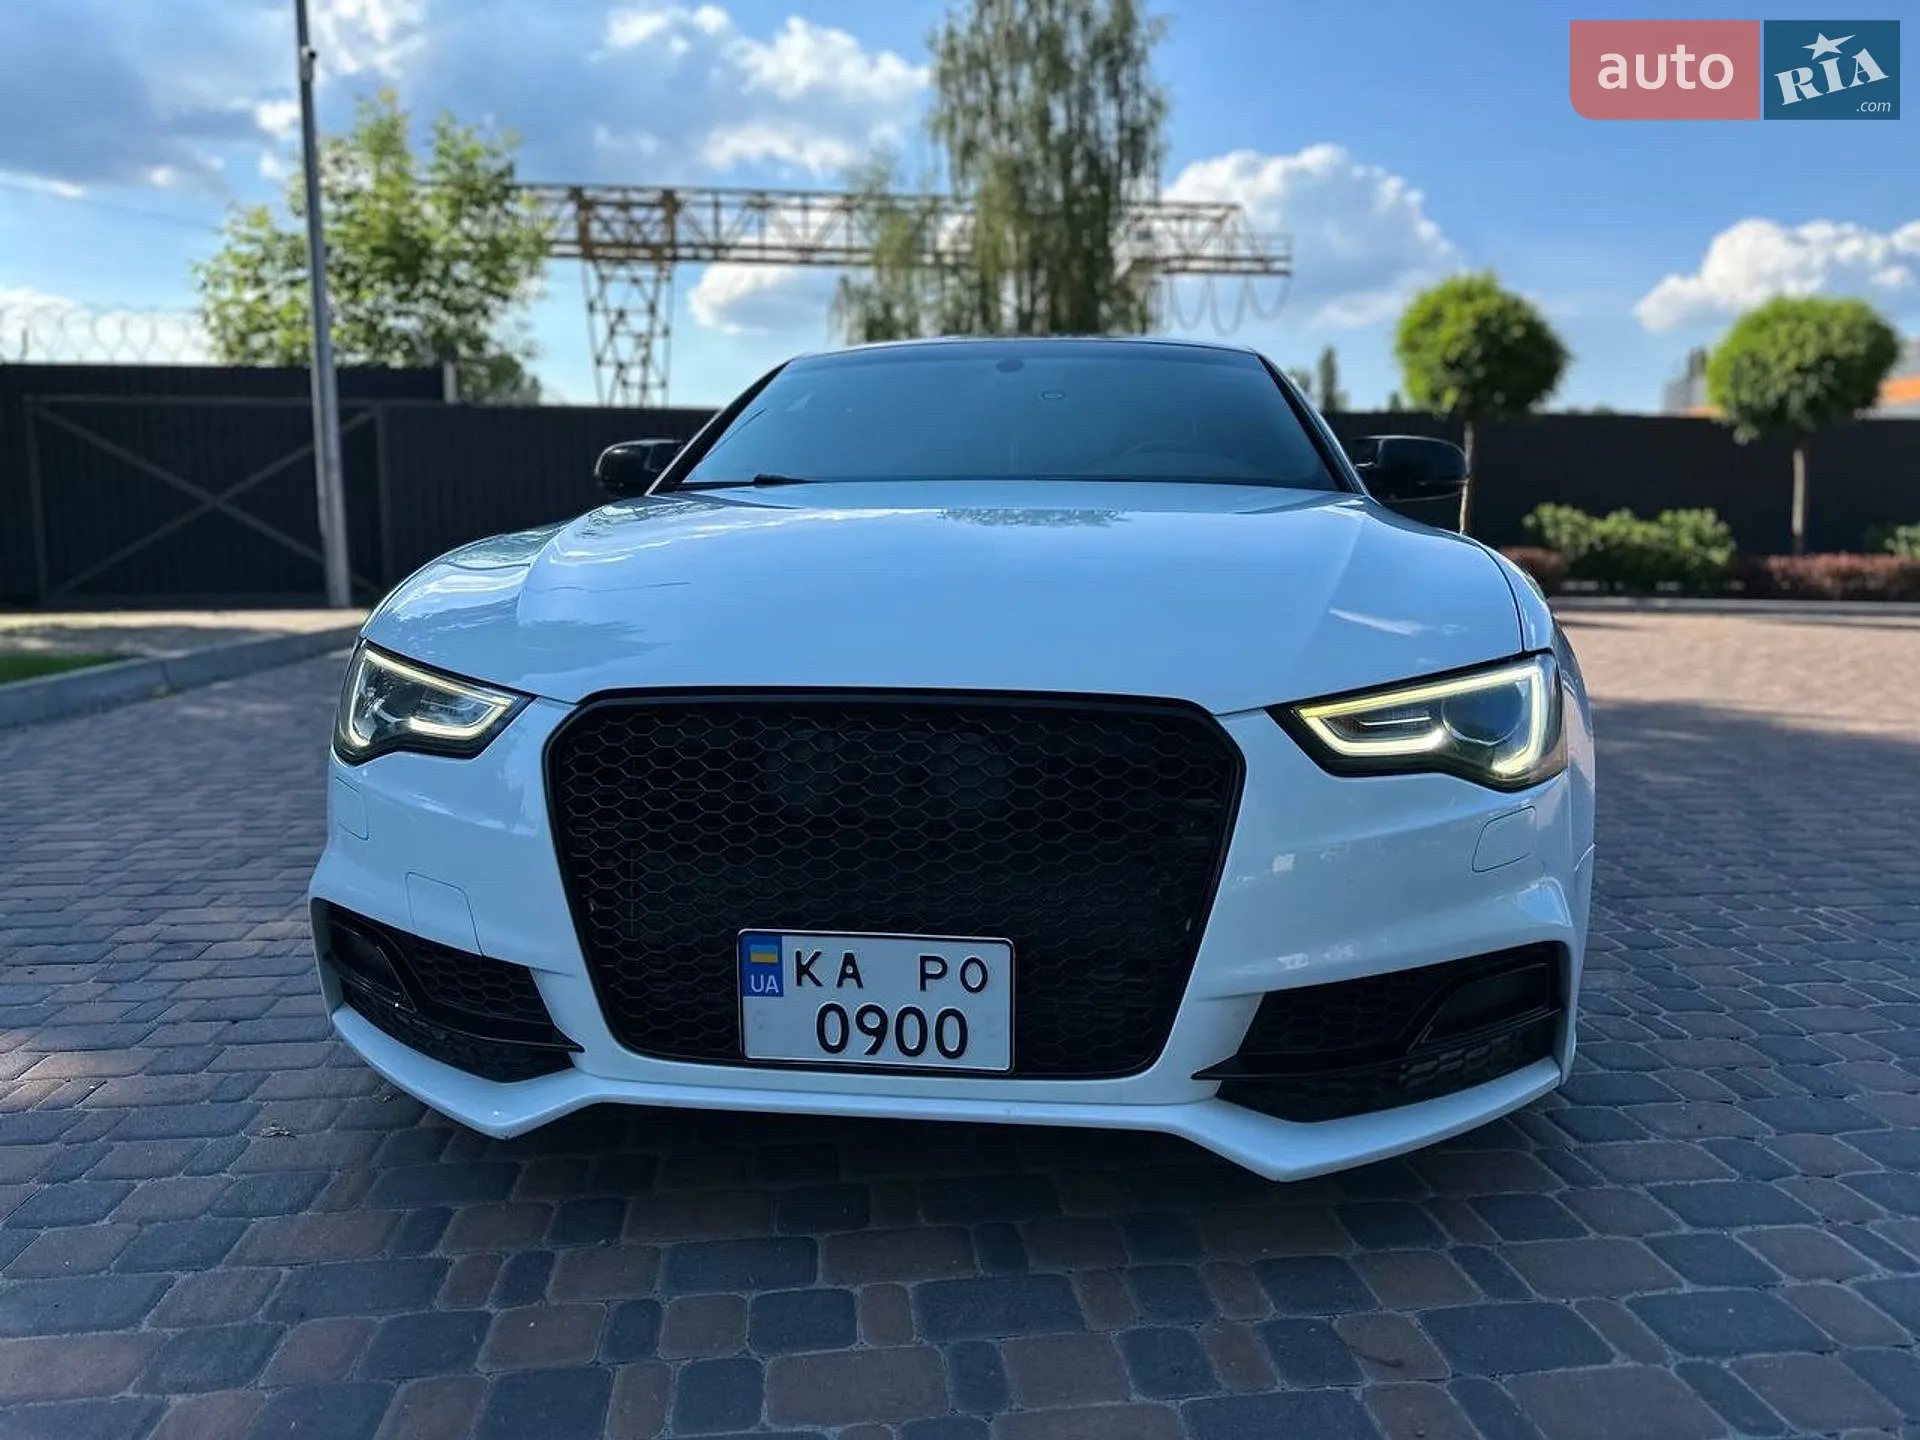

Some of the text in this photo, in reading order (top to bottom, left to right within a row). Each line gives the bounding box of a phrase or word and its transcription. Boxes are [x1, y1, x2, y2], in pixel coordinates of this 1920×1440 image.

[751, 974, 779, 994] UA
[795, 950, 988, 993] KA PO
[816, 1003, 969, 1059] 0900
